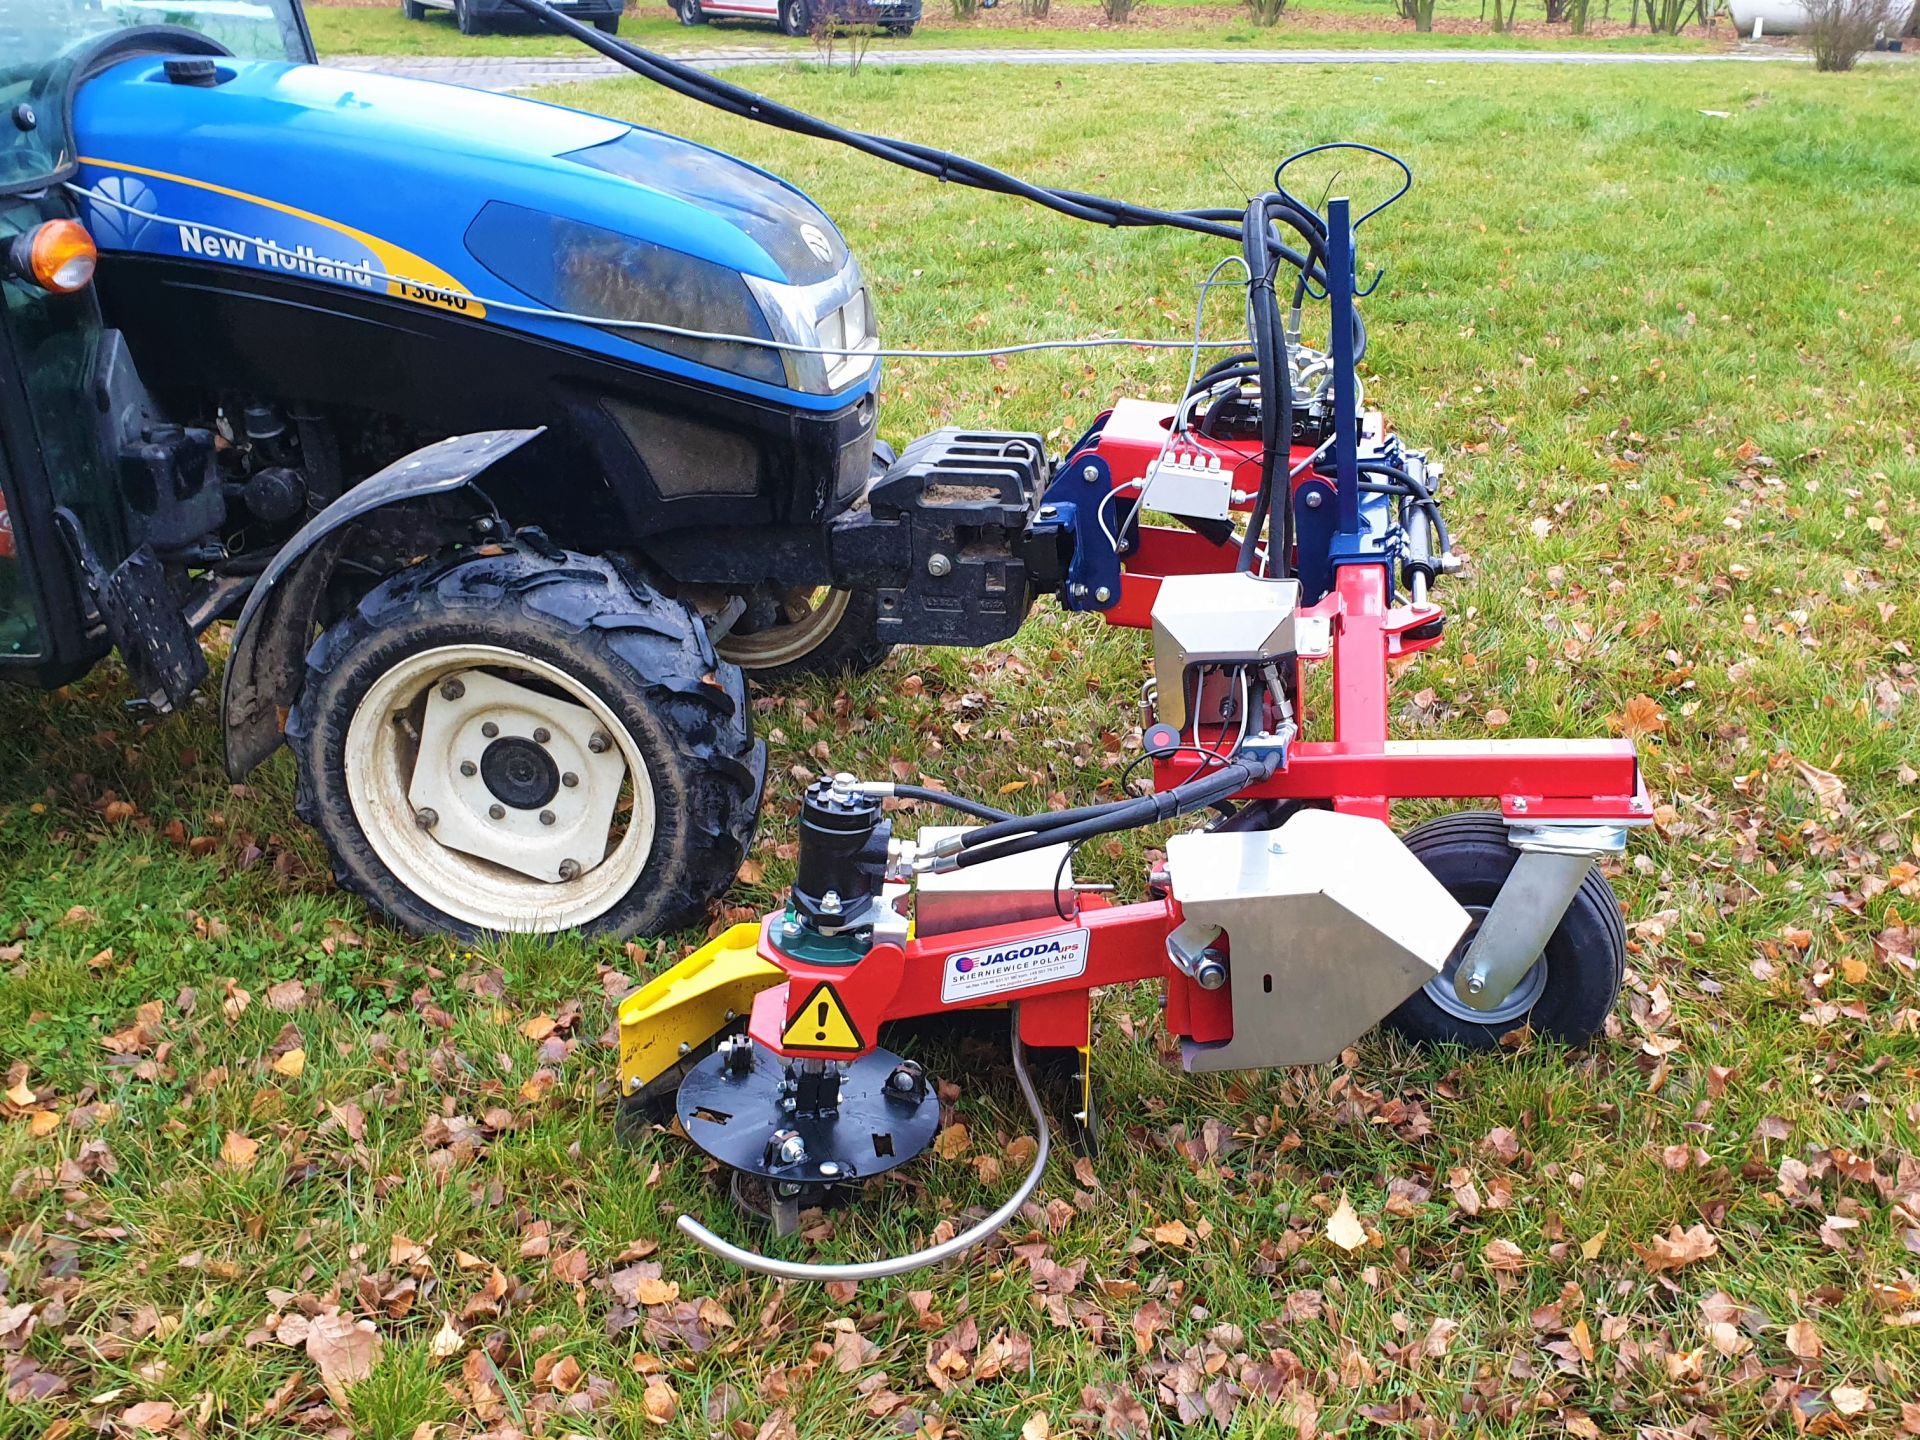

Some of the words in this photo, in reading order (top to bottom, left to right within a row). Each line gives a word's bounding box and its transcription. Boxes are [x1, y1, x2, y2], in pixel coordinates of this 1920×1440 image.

[179, 225, 246, 261] New
[255, 236, 372, 286] Holland
[953, 960, 1029, 983] SKIERNIEWICE
[1033, 953, 1075, 966] POLAND
[980, 941, 1060, 966] JAGODA
